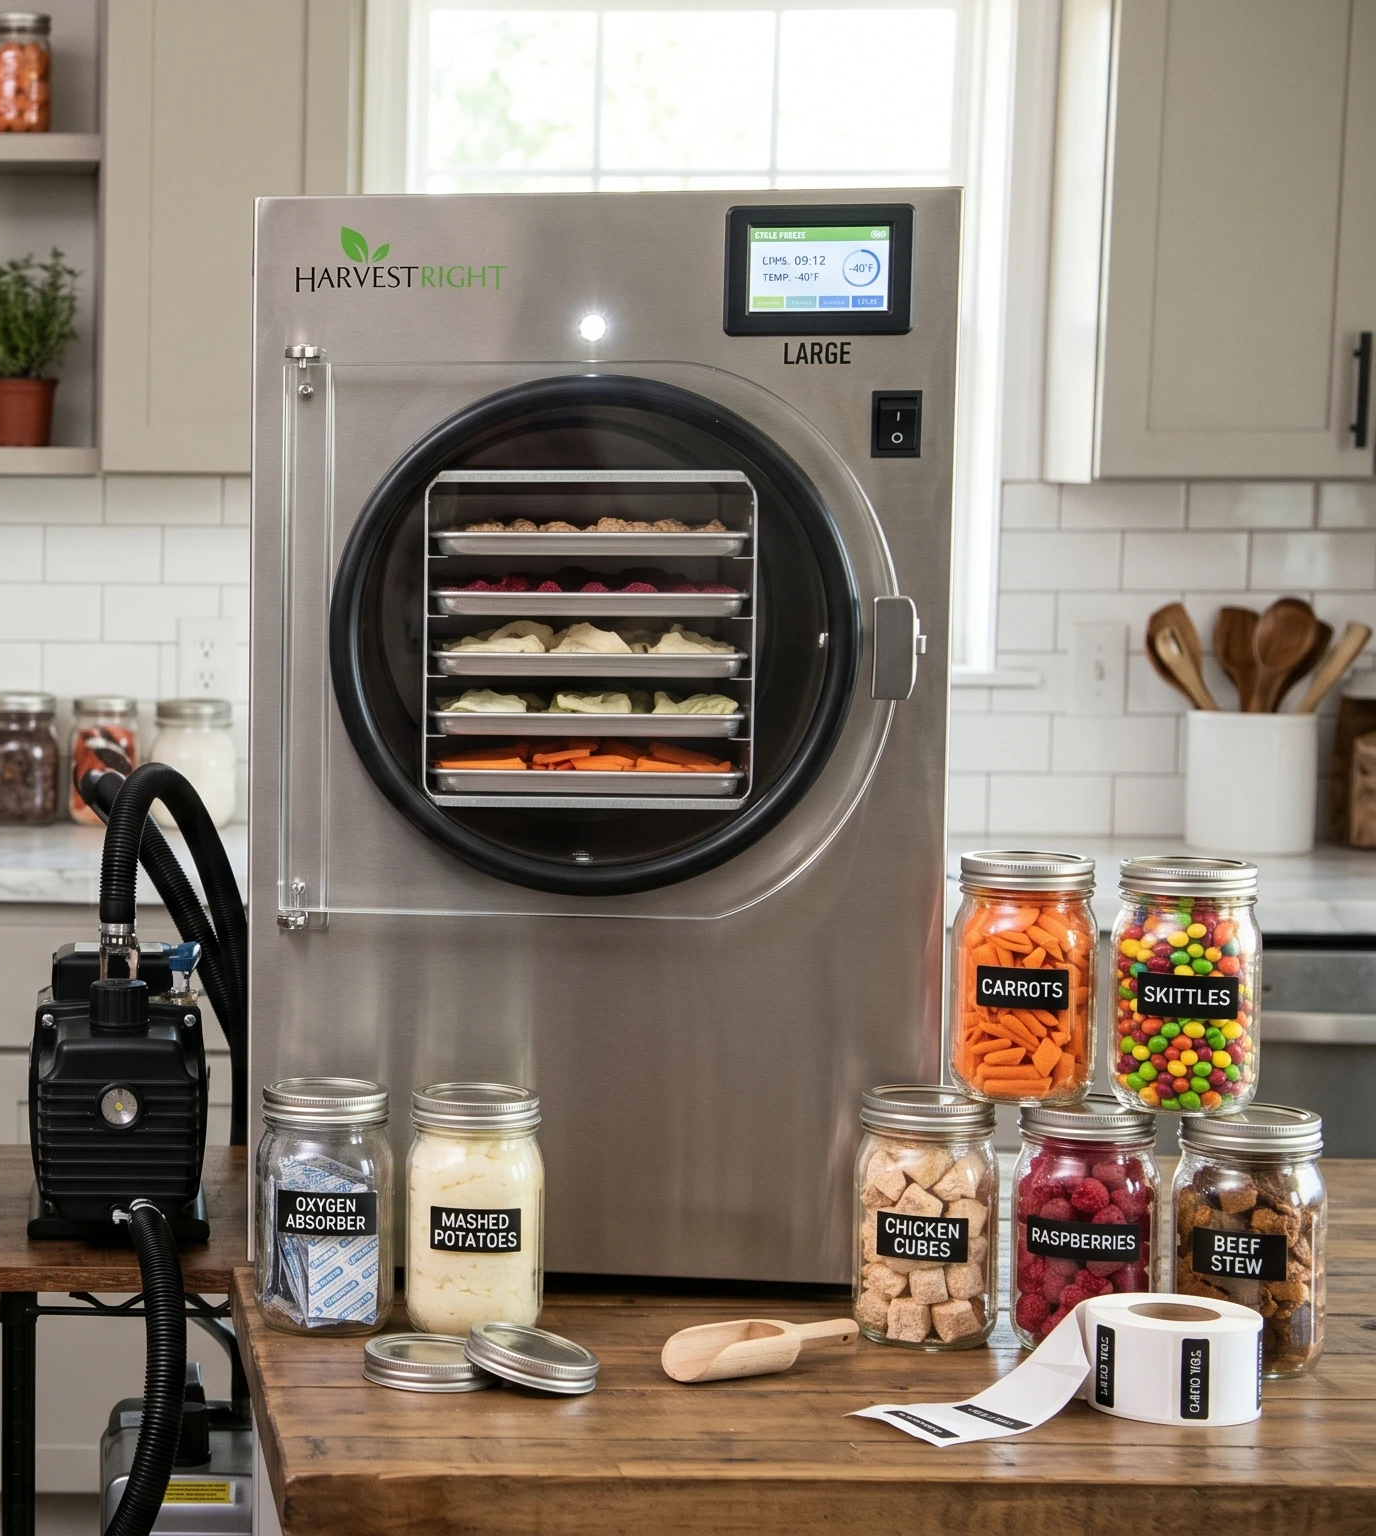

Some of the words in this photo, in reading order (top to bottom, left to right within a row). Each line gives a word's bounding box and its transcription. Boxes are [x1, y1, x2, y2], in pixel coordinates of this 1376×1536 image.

[794, 255, 827, 266] 09:12
[783, 341, 852, 365] LARGE
[981, 978, 1064, 999] CARROTS
[1143, 985, 1231, 1007] SKITTLES
[295, 1196, 357, 1214] OXYGEN
[285, 1213, 367, 1231] ABSORBER
[441, 1211, 510, 1230] MASHED
[884, 1217, 961, 1240] CHICKEN
[434, 1229, 518, 1249] POTATOES
[893, 1237, 952, 1258] CUBES
[1031, 1226, 1137, 1251] RASPBERRIES
[1213, 1234, 1262, 1255] BEEF
[1210, 1254, 1264, 1276] STEW
